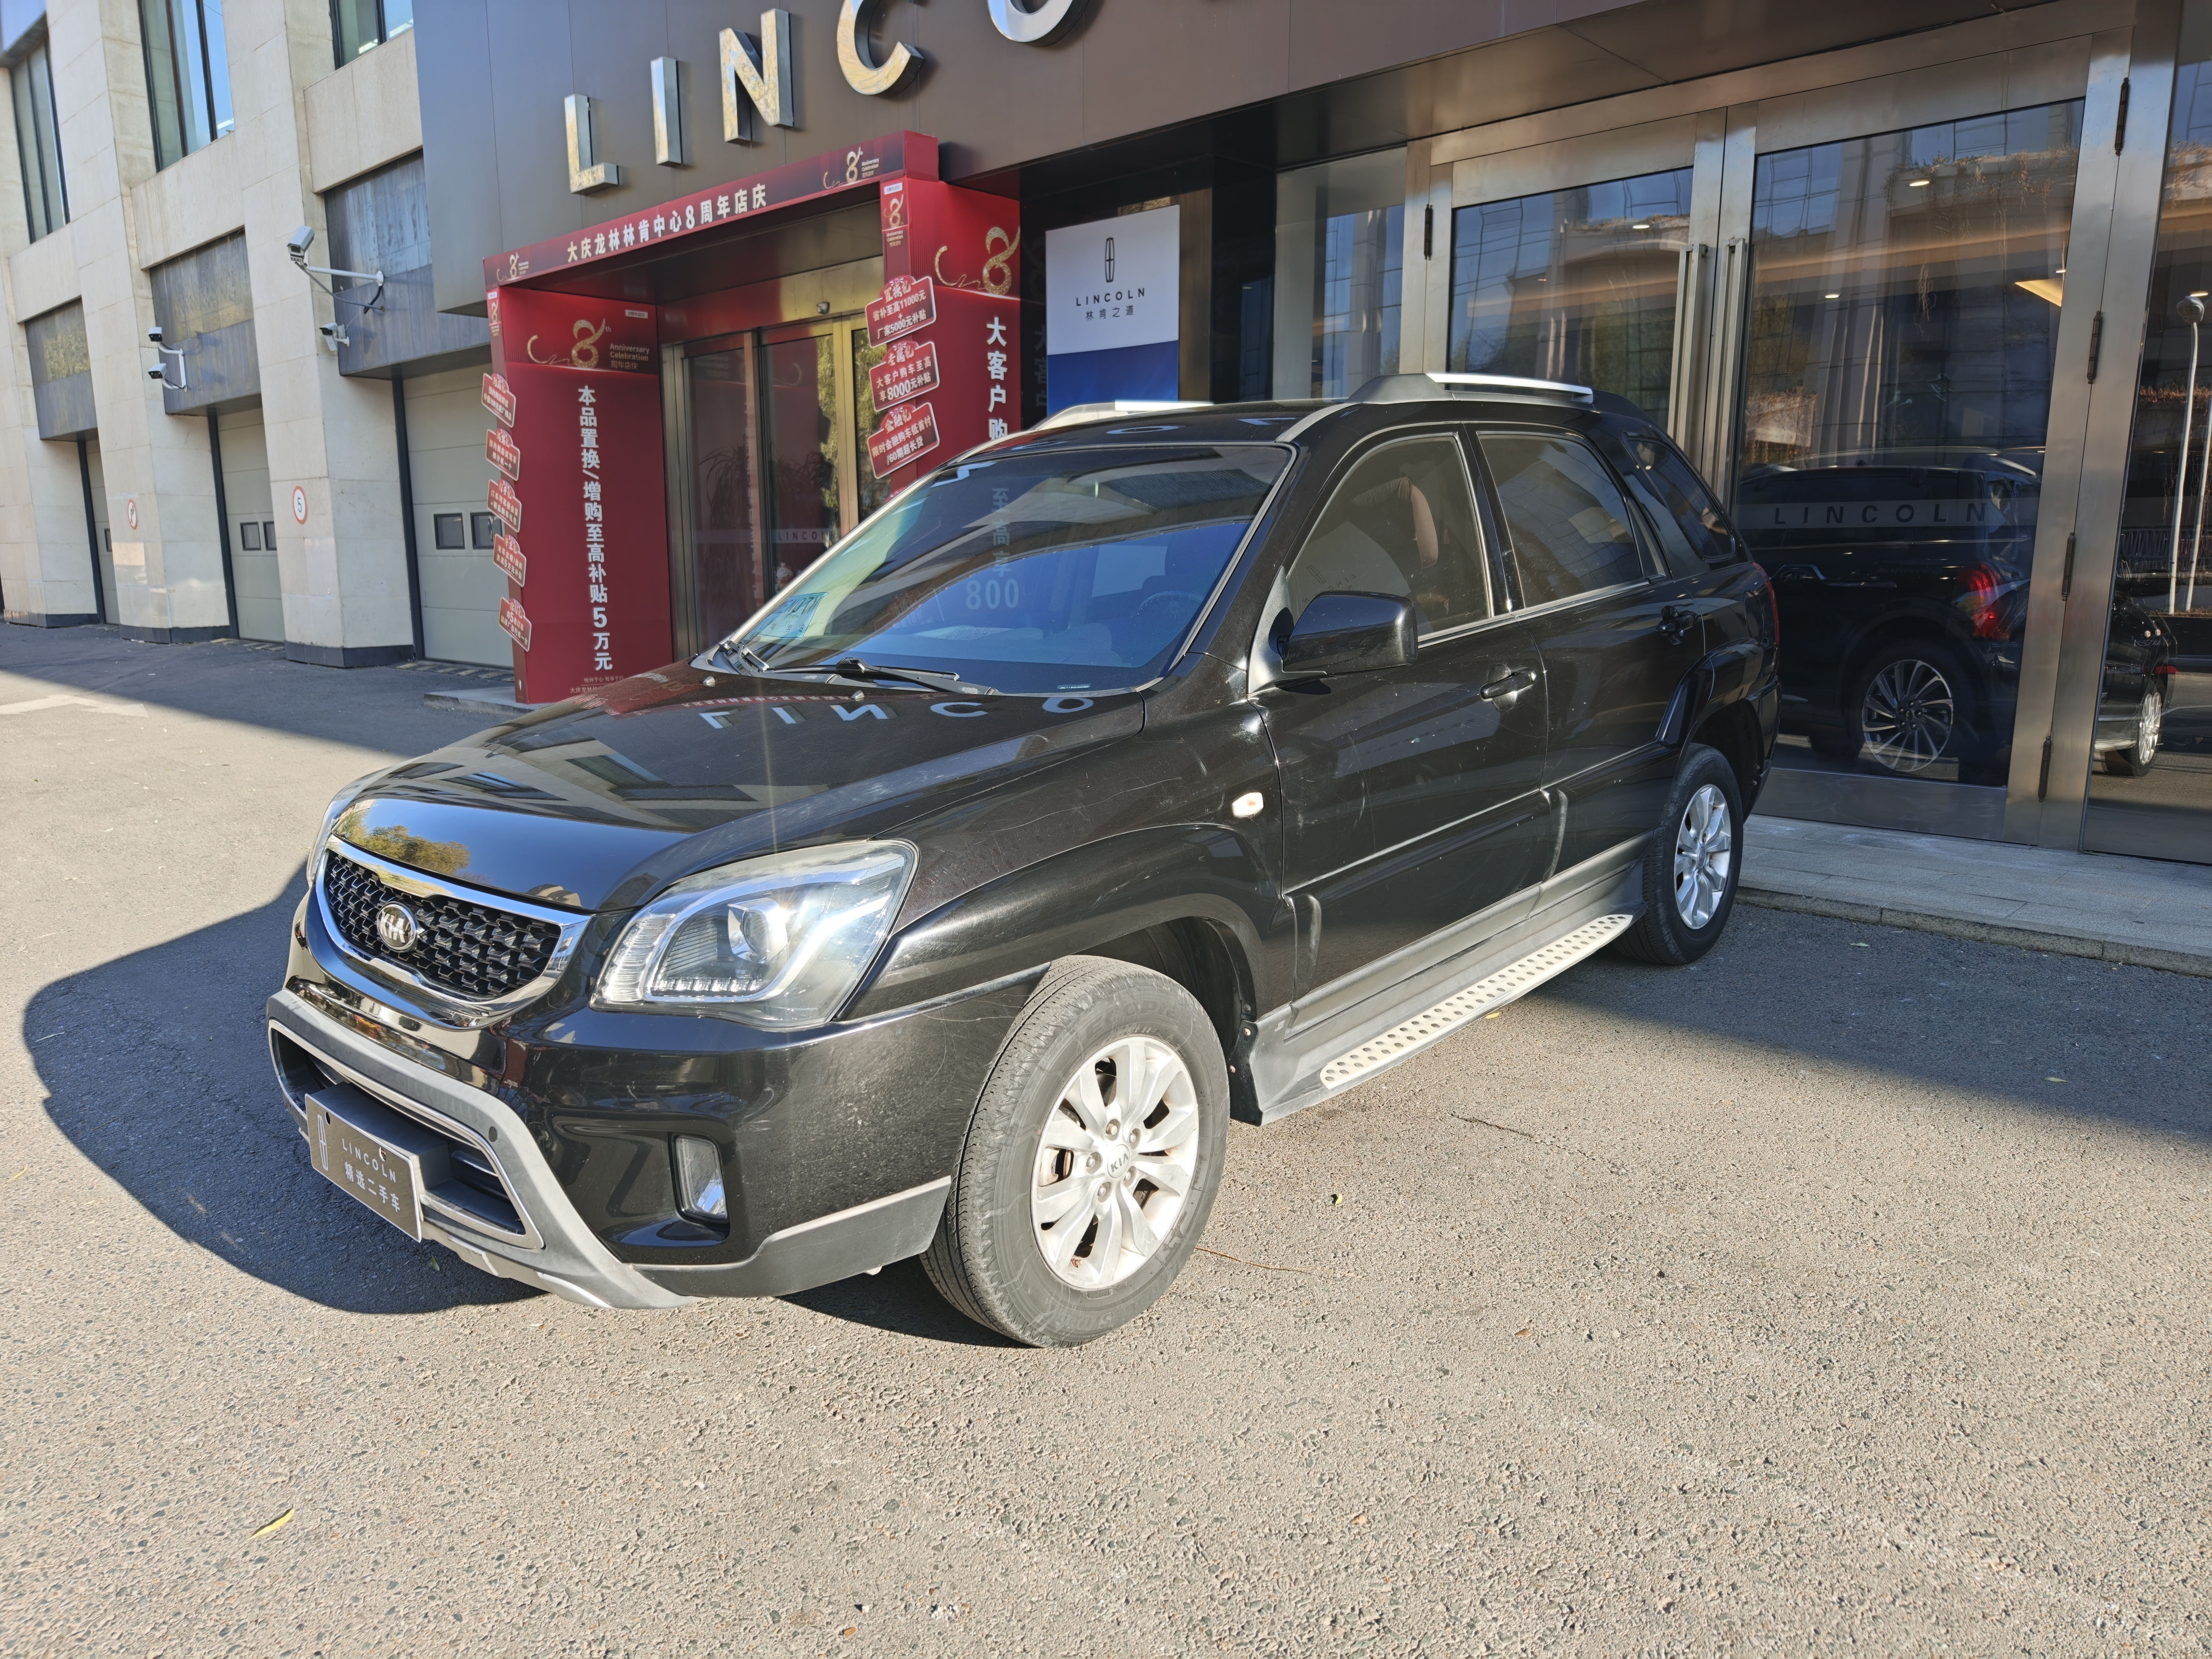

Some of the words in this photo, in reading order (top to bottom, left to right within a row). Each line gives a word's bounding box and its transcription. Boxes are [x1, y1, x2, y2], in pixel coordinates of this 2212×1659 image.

[567, 183, 767, 263] 大庆龙林林肯中心8周年店庆
[884, 280, 911, 304] 置换礼
[1076, 287, 1145, 307] LINCOLN
[878, 308, 926, 340] 厂家5000元补贴
[1086, 305, 1134, 321] 林肯之道
[610, 343, 650, 355] Anniversary
[610, 351, 648, 361] Celebration
[611, 360, 638, 370] 周年店庆
[876, 355, 932, 389] 大客户购车至高
[986, 317, 1008, 440] 大客户购
[879, 371, 932, 402] 享8000元补贴
[871, 415, 931, 458] 限时金融购车低首付
[297, 497, 302, 513] 5
[1774, 502, 1987, 525] LINCOLN
[577, 384, 613, 671] 本品置换/增购至高补贴5万元
[380, 909, 406, 943] KIA
[342, 1138, 396, 1183] LINCOLN
[1110, 1153, 1129, 1173] KIA
[344, 1161, 400, 1213] 精选二手车
